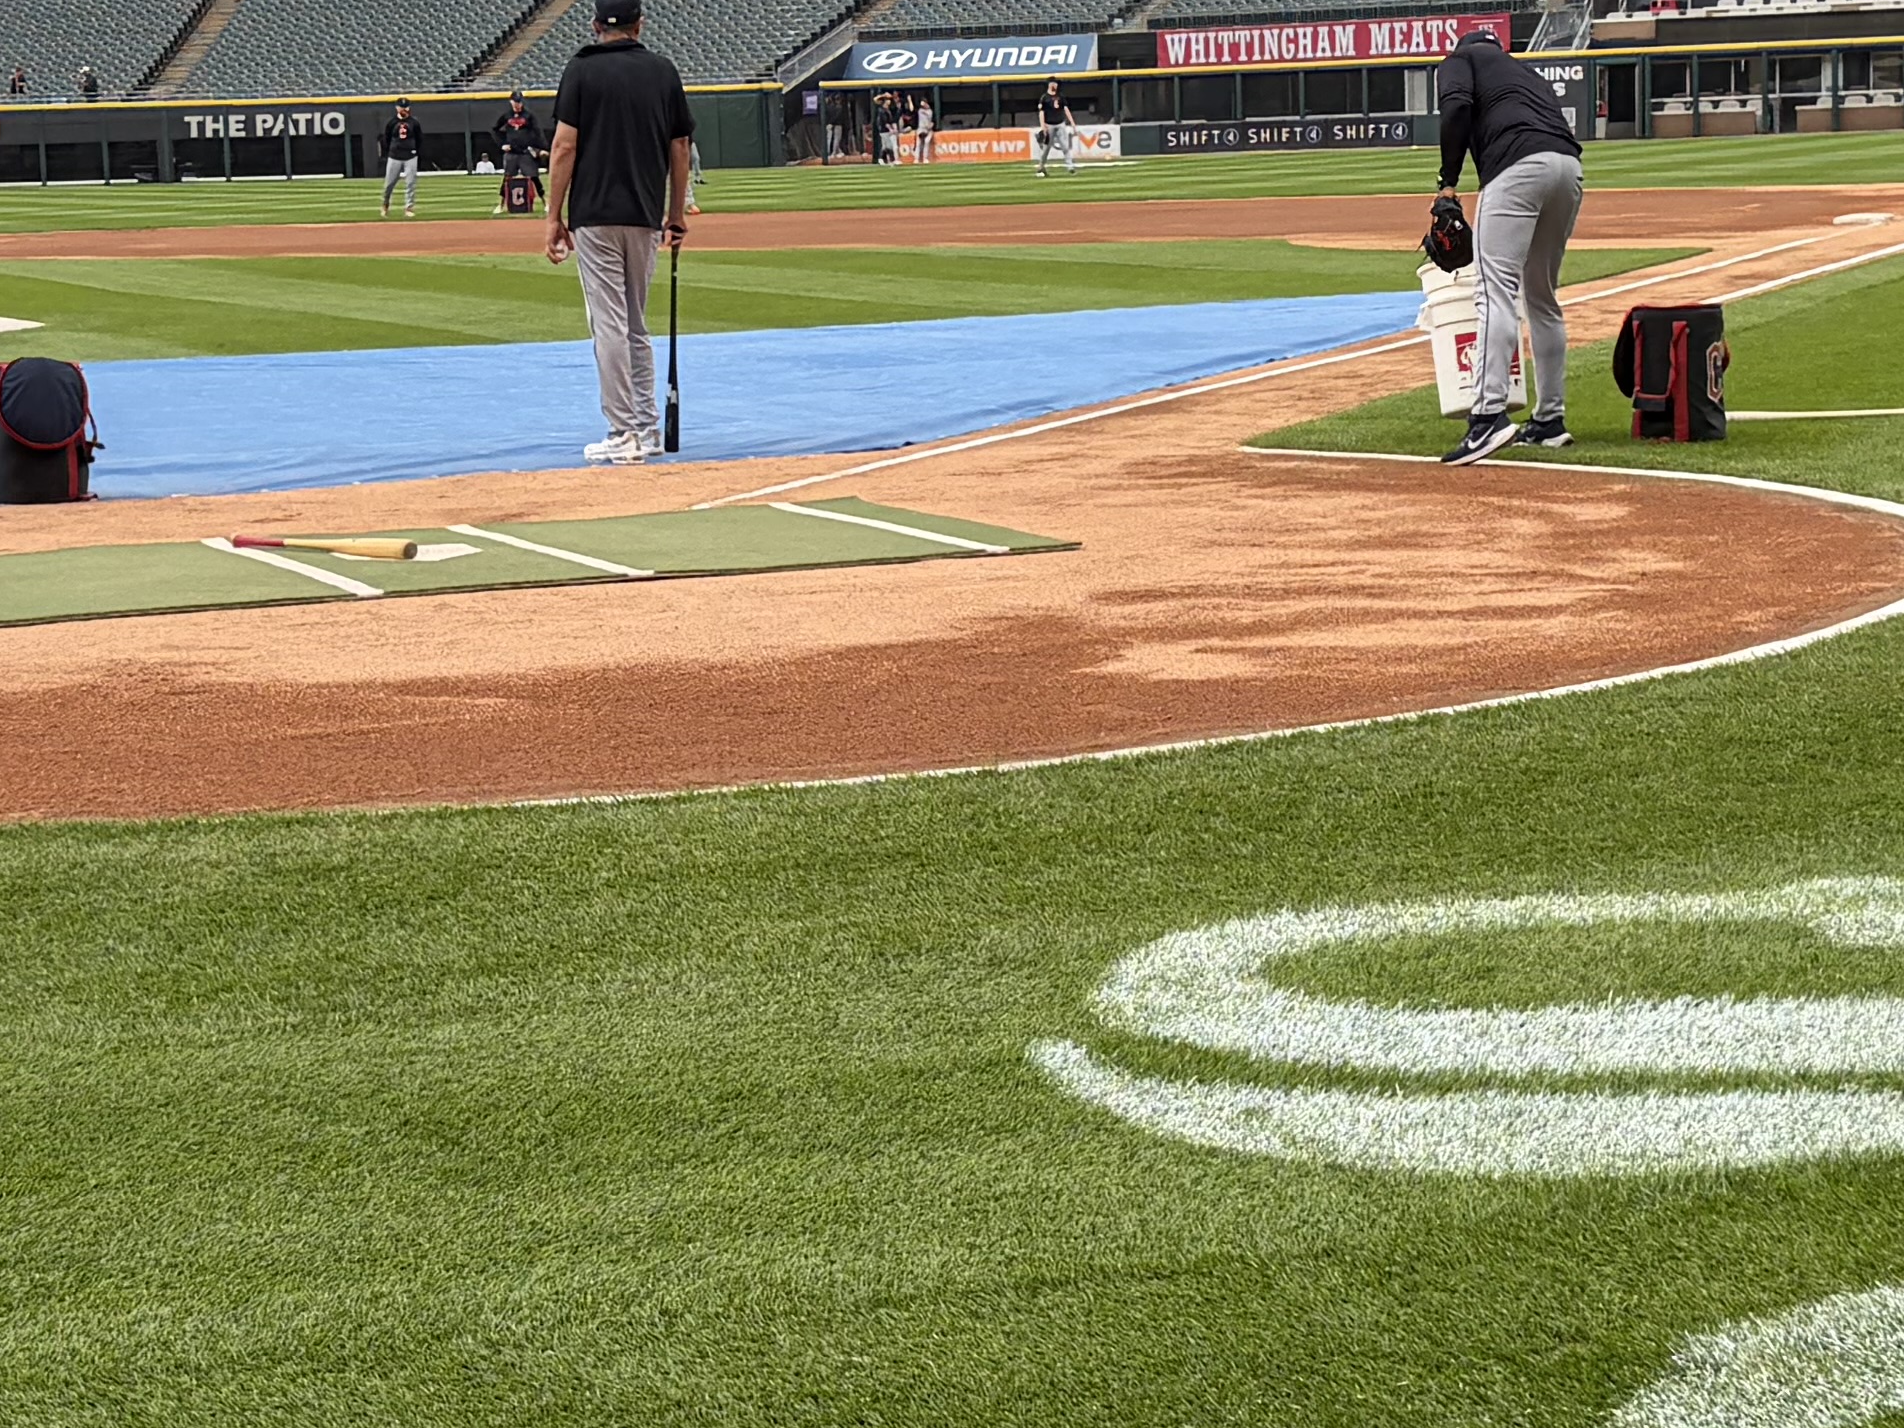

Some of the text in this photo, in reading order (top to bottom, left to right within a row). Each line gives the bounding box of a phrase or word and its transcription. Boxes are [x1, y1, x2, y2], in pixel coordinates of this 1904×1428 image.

[1165, 18, 1459, 66] WHITTINGHAM MEATS
[924, 44, 1078, 71] HYUNDAI
[183, 112, 346, 139] THE PATIO
